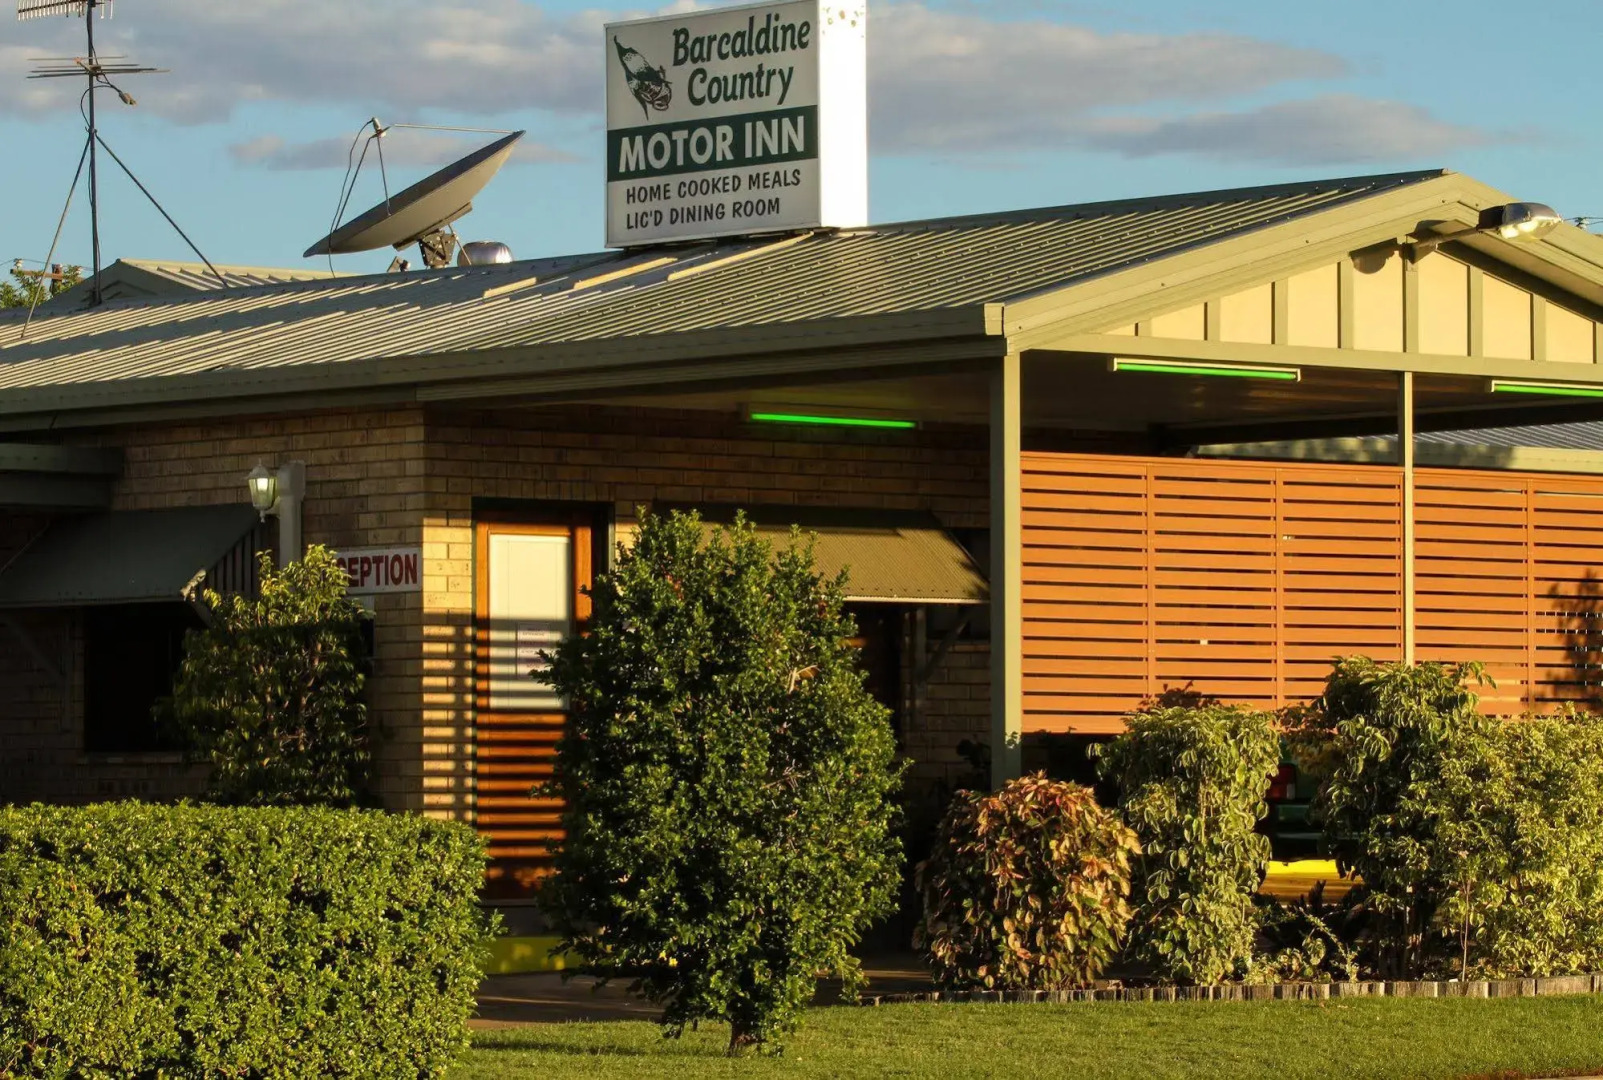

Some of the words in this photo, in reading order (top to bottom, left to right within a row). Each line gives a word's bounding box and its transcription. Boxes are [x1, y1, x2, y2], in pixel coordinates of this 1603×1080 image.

[672, 13, 811, 67] Barcaldine
[687, 62, 794, 107] Country
[618, 124, 734, 173] MOTOR
[744, 115, 805, 159] INN
[626, 183, 672, 205] HOME
[677, 175, 741, 199] COOKED
[748, 168, 801, 191] MEALS
[626, 209, 663, 230] LIC'D
[669, 203, 725, 225] DINING
[732, 197, 780, 218] ROOM
[336, 553, 418, 588] EPTION
